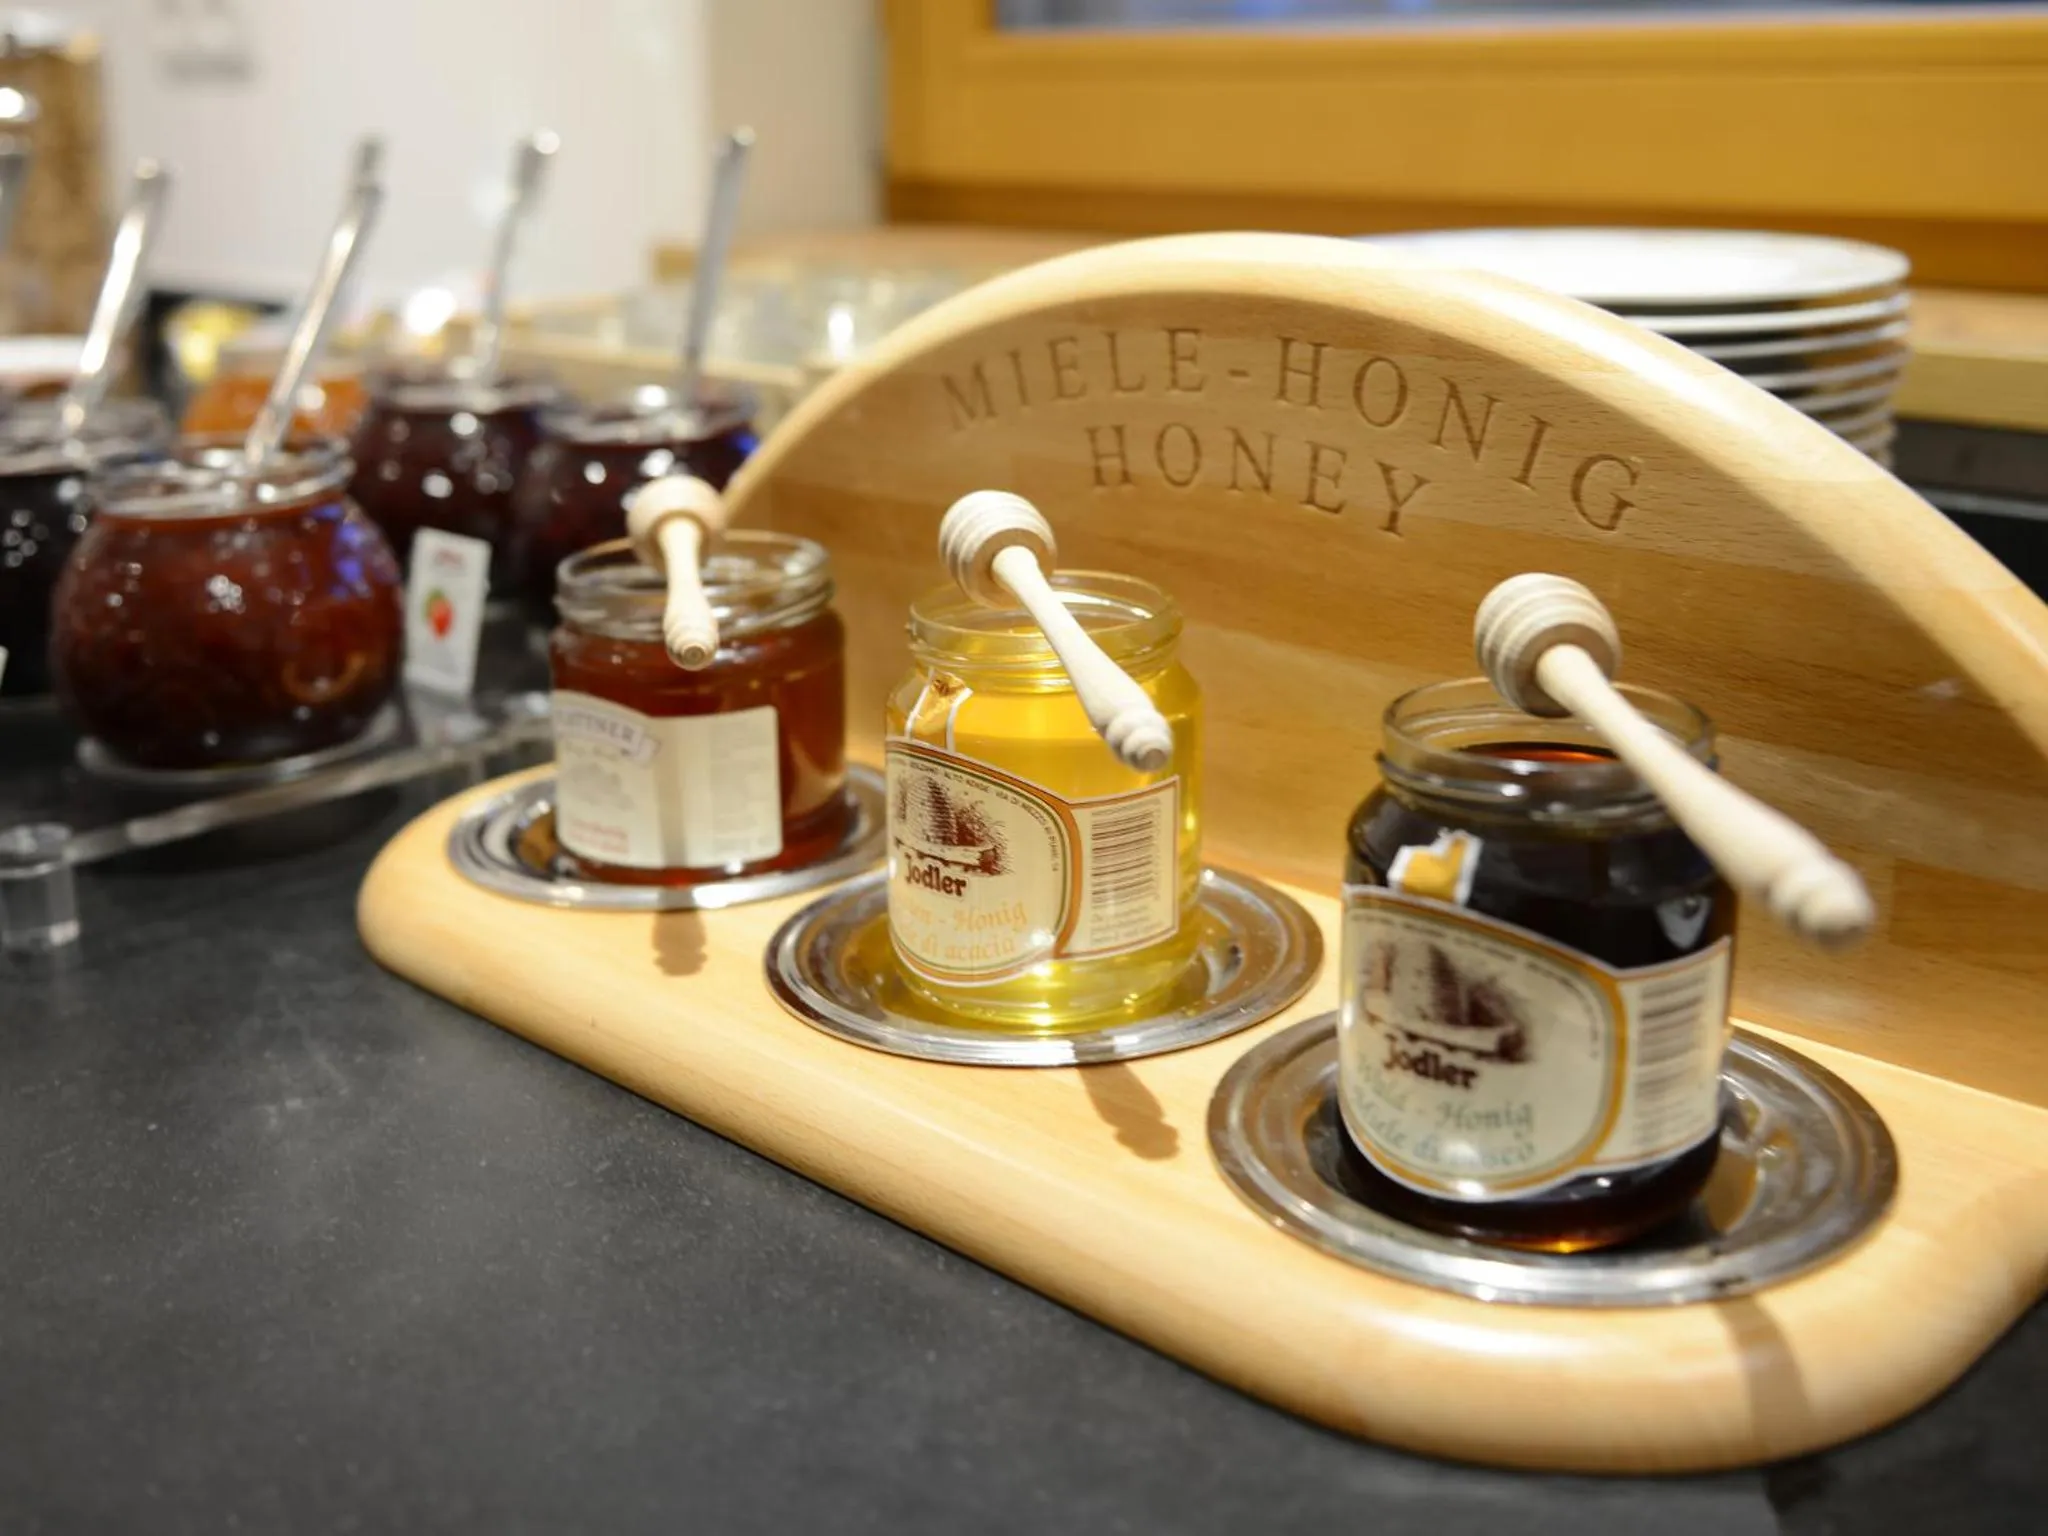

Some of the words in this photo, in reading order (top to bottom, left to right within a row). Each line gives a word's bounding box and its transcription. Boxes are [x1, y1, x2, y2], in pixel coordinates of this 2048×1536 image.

[940, 327, 1642, 533] MIELE-HONIG
[1085, 421, 1430, 538] HONEY
[904, 852, 968, 897] Jodler
[1382, 1033, 1479, 1090] Jodler
